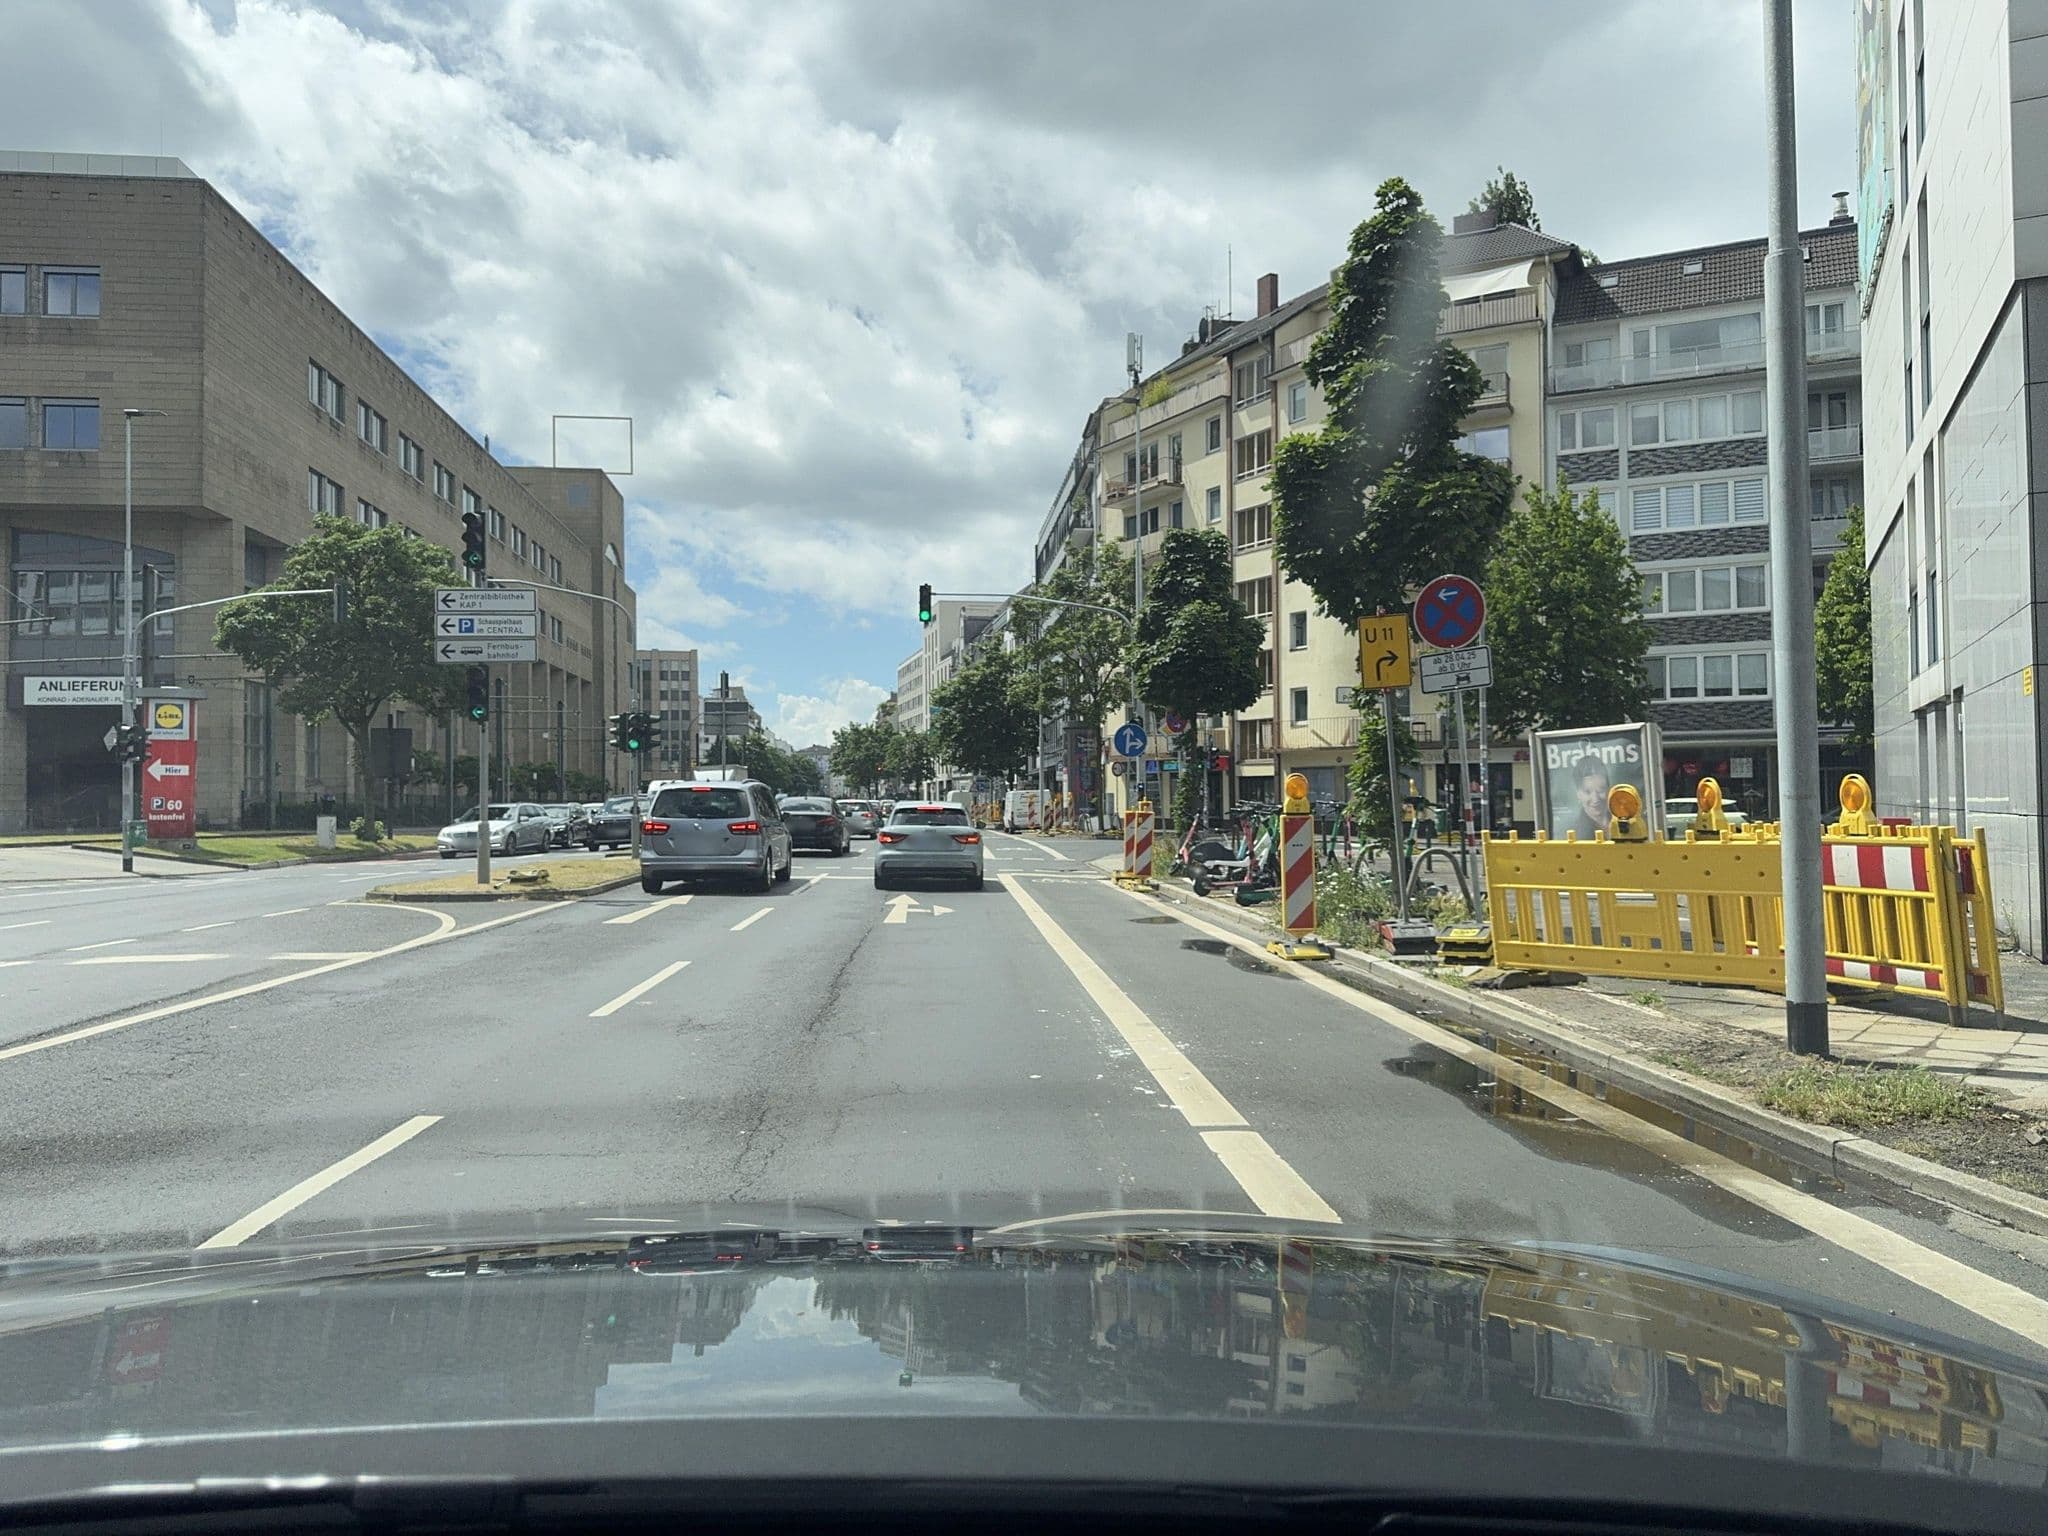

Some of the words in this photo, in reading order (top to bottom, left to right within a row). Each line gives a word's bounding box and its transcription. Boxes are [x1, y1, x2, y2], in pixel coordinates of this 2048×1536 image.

[462, 620, 471, 632] P
[1365, 628, 1377, 643] U
[1383, 628, 1393, 640] 11
[1439, 664, 1447, 672] ab
[1457, 661, 1471, 669] Uhr
[1545, 739, 1639, 769] Brahms
[153, 799, 162, 809] P
[167, 800, 182, 810] 60
